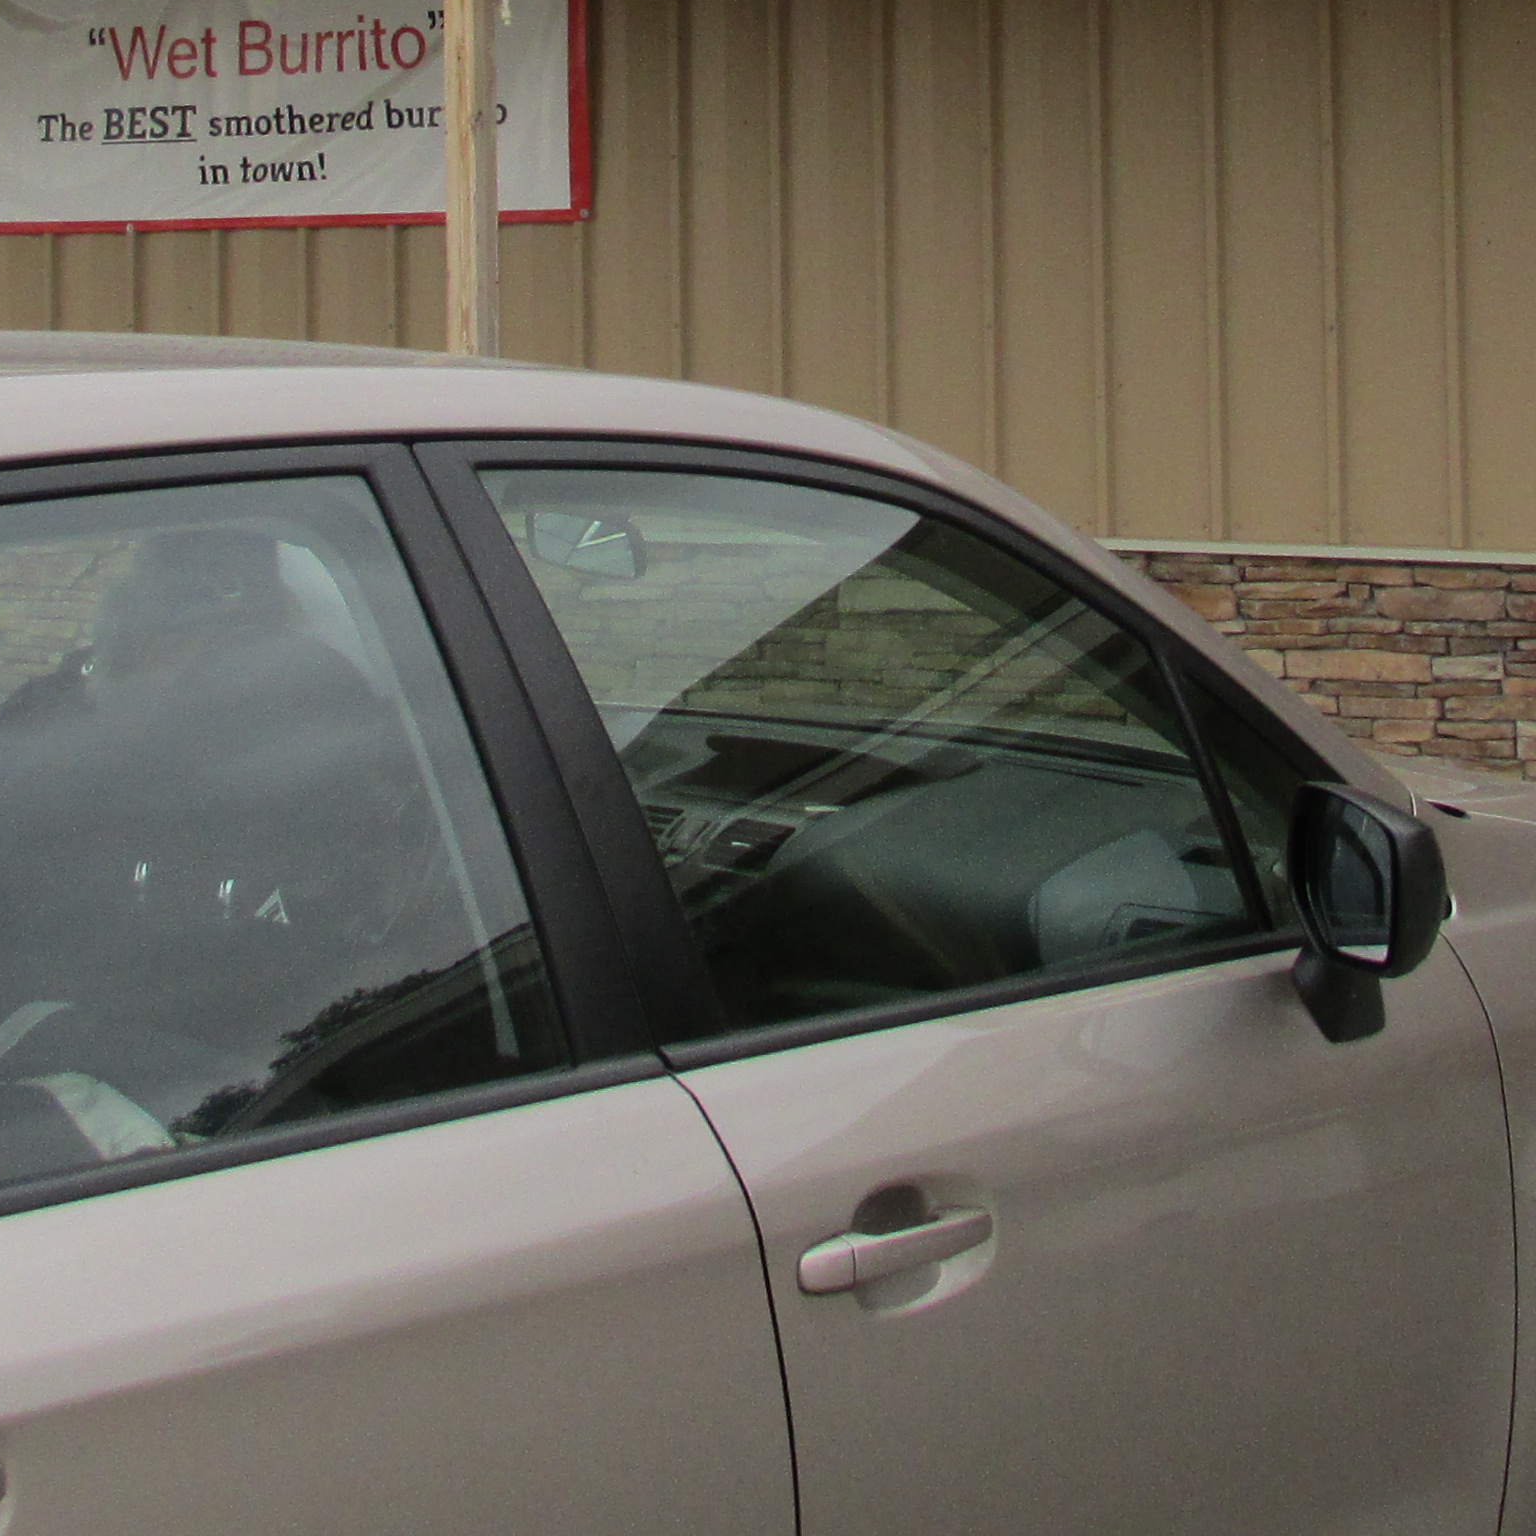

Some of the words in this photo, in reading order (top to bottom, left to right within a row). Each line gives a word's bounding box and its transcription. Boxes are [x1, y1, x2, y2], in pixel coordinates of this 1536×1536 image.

[37, 113, 94, 143] The
[101, 105, 197, 145] BEST
[208, 100, 375, 137] smothered
[383, 98, 507, 129] buro
[198, 154, 230, 186] in
[240, 152, 328, 184] town!
